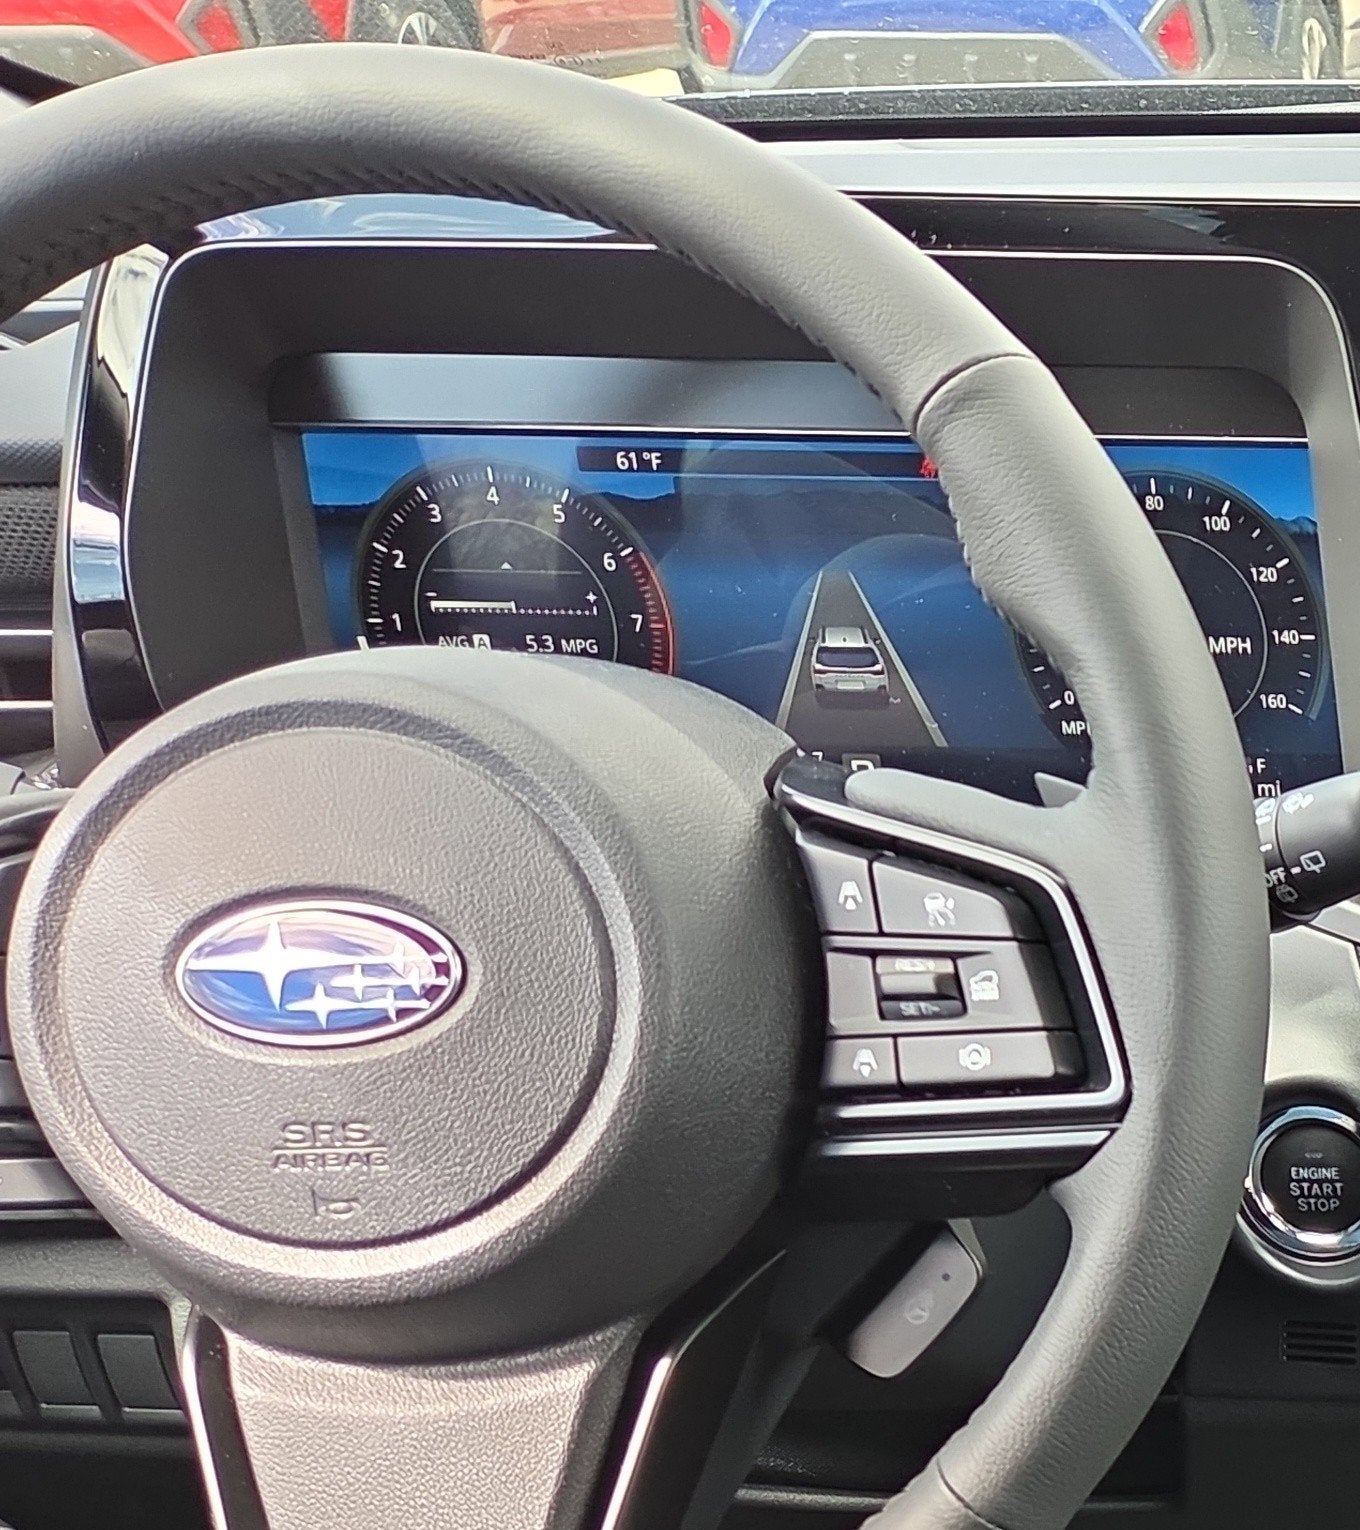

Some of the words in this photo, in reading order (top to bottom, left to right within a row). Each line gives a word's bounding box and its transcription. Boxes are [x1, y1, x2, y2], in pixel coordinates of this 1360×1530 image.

[486, 486, 500, 504] 4
[1145, 496, 1164, 511] 80
[429, 503, 442, 523] 3
[553, 506, 566, 524] 5
[1203, 515, 1231, 532] 100
[392, 550, 406, 569] 2
[603, 553, 617, 572] 6
[1251, 567, 1278, 582] 120
[392, 612, 402, 632] 1
[631, 614, 645, 633] 7
[525, 635, 555, 653] 5.3
[561, 638, 598, 654] MPG
[1209, 636, 1251, 655] MPH
[1272, 630, 1300, 646] 140
[1064, 690, 1075, 706] 0
[1260, 694, 1287, 710] 160
[1061, 720, 1091, 736] MP
[1290, 1167, 1341, 1180] ENGINE
[1289, 1182, 1344, 1197] START
[1297, 1198, 1341, 1212] STOP
